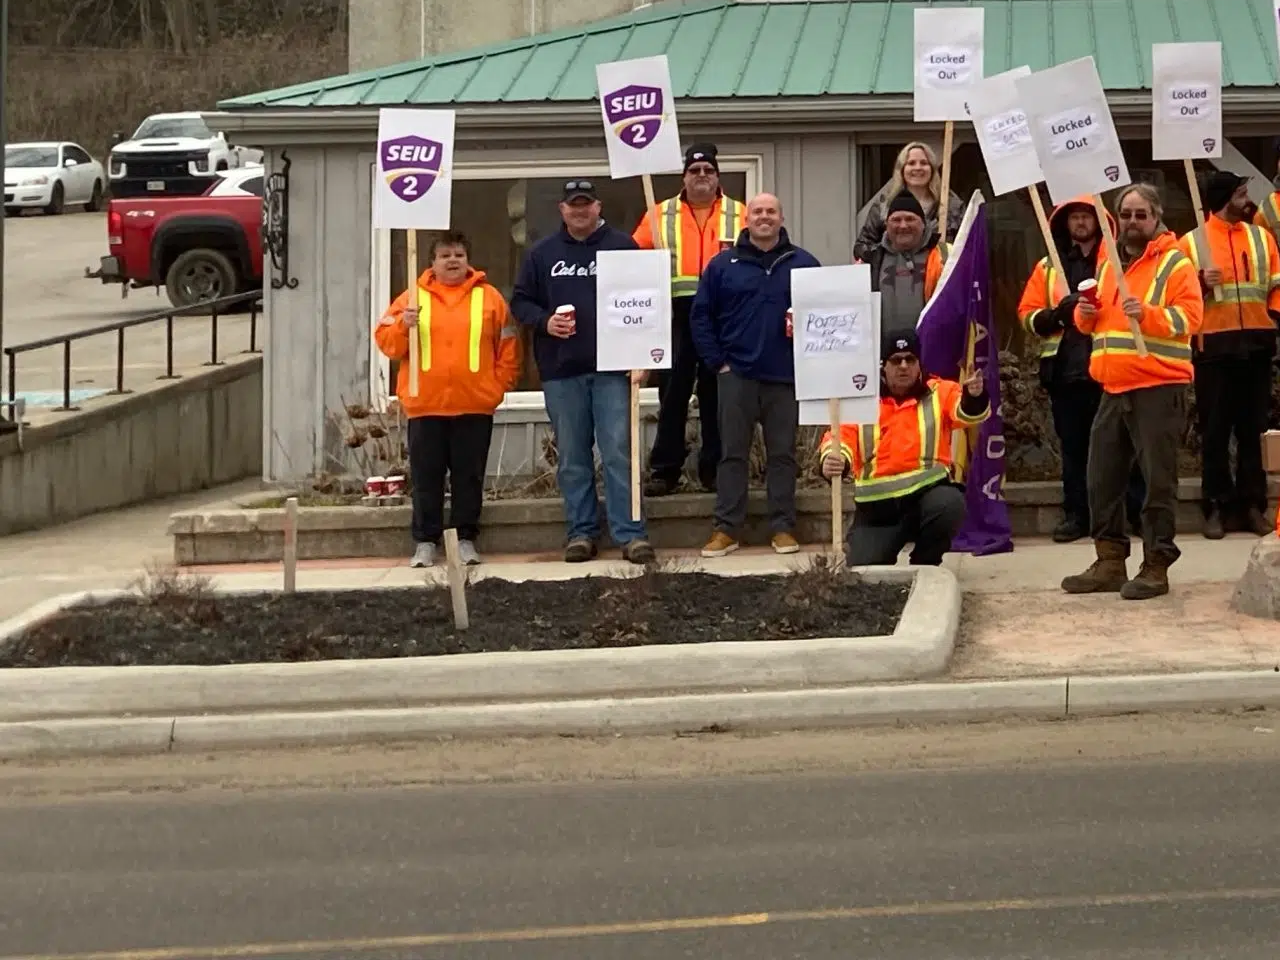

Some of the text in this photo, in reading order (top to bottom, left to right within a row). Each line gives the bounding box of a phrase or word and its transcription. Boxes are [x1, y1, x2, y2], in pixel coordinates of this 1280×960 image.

[930, 54, 965, 64] Locked
[938, 71, 957, 79] Out
[1172, 89, 1207, 100] Locked
[610, 92, 657, 114] SEIU
[1180, 106, 1199, 115] Out
[1051, 116, 1092, 135] Locked
[631, 123, 647, 143] 2
[1065, 137, 1089, 151] Out
[386, 145, 437, 162] SEIU
[402, 176, 418, 195] 2
[614, 298, 652, 309] Locked
[623, 315, 643, 325] Out
